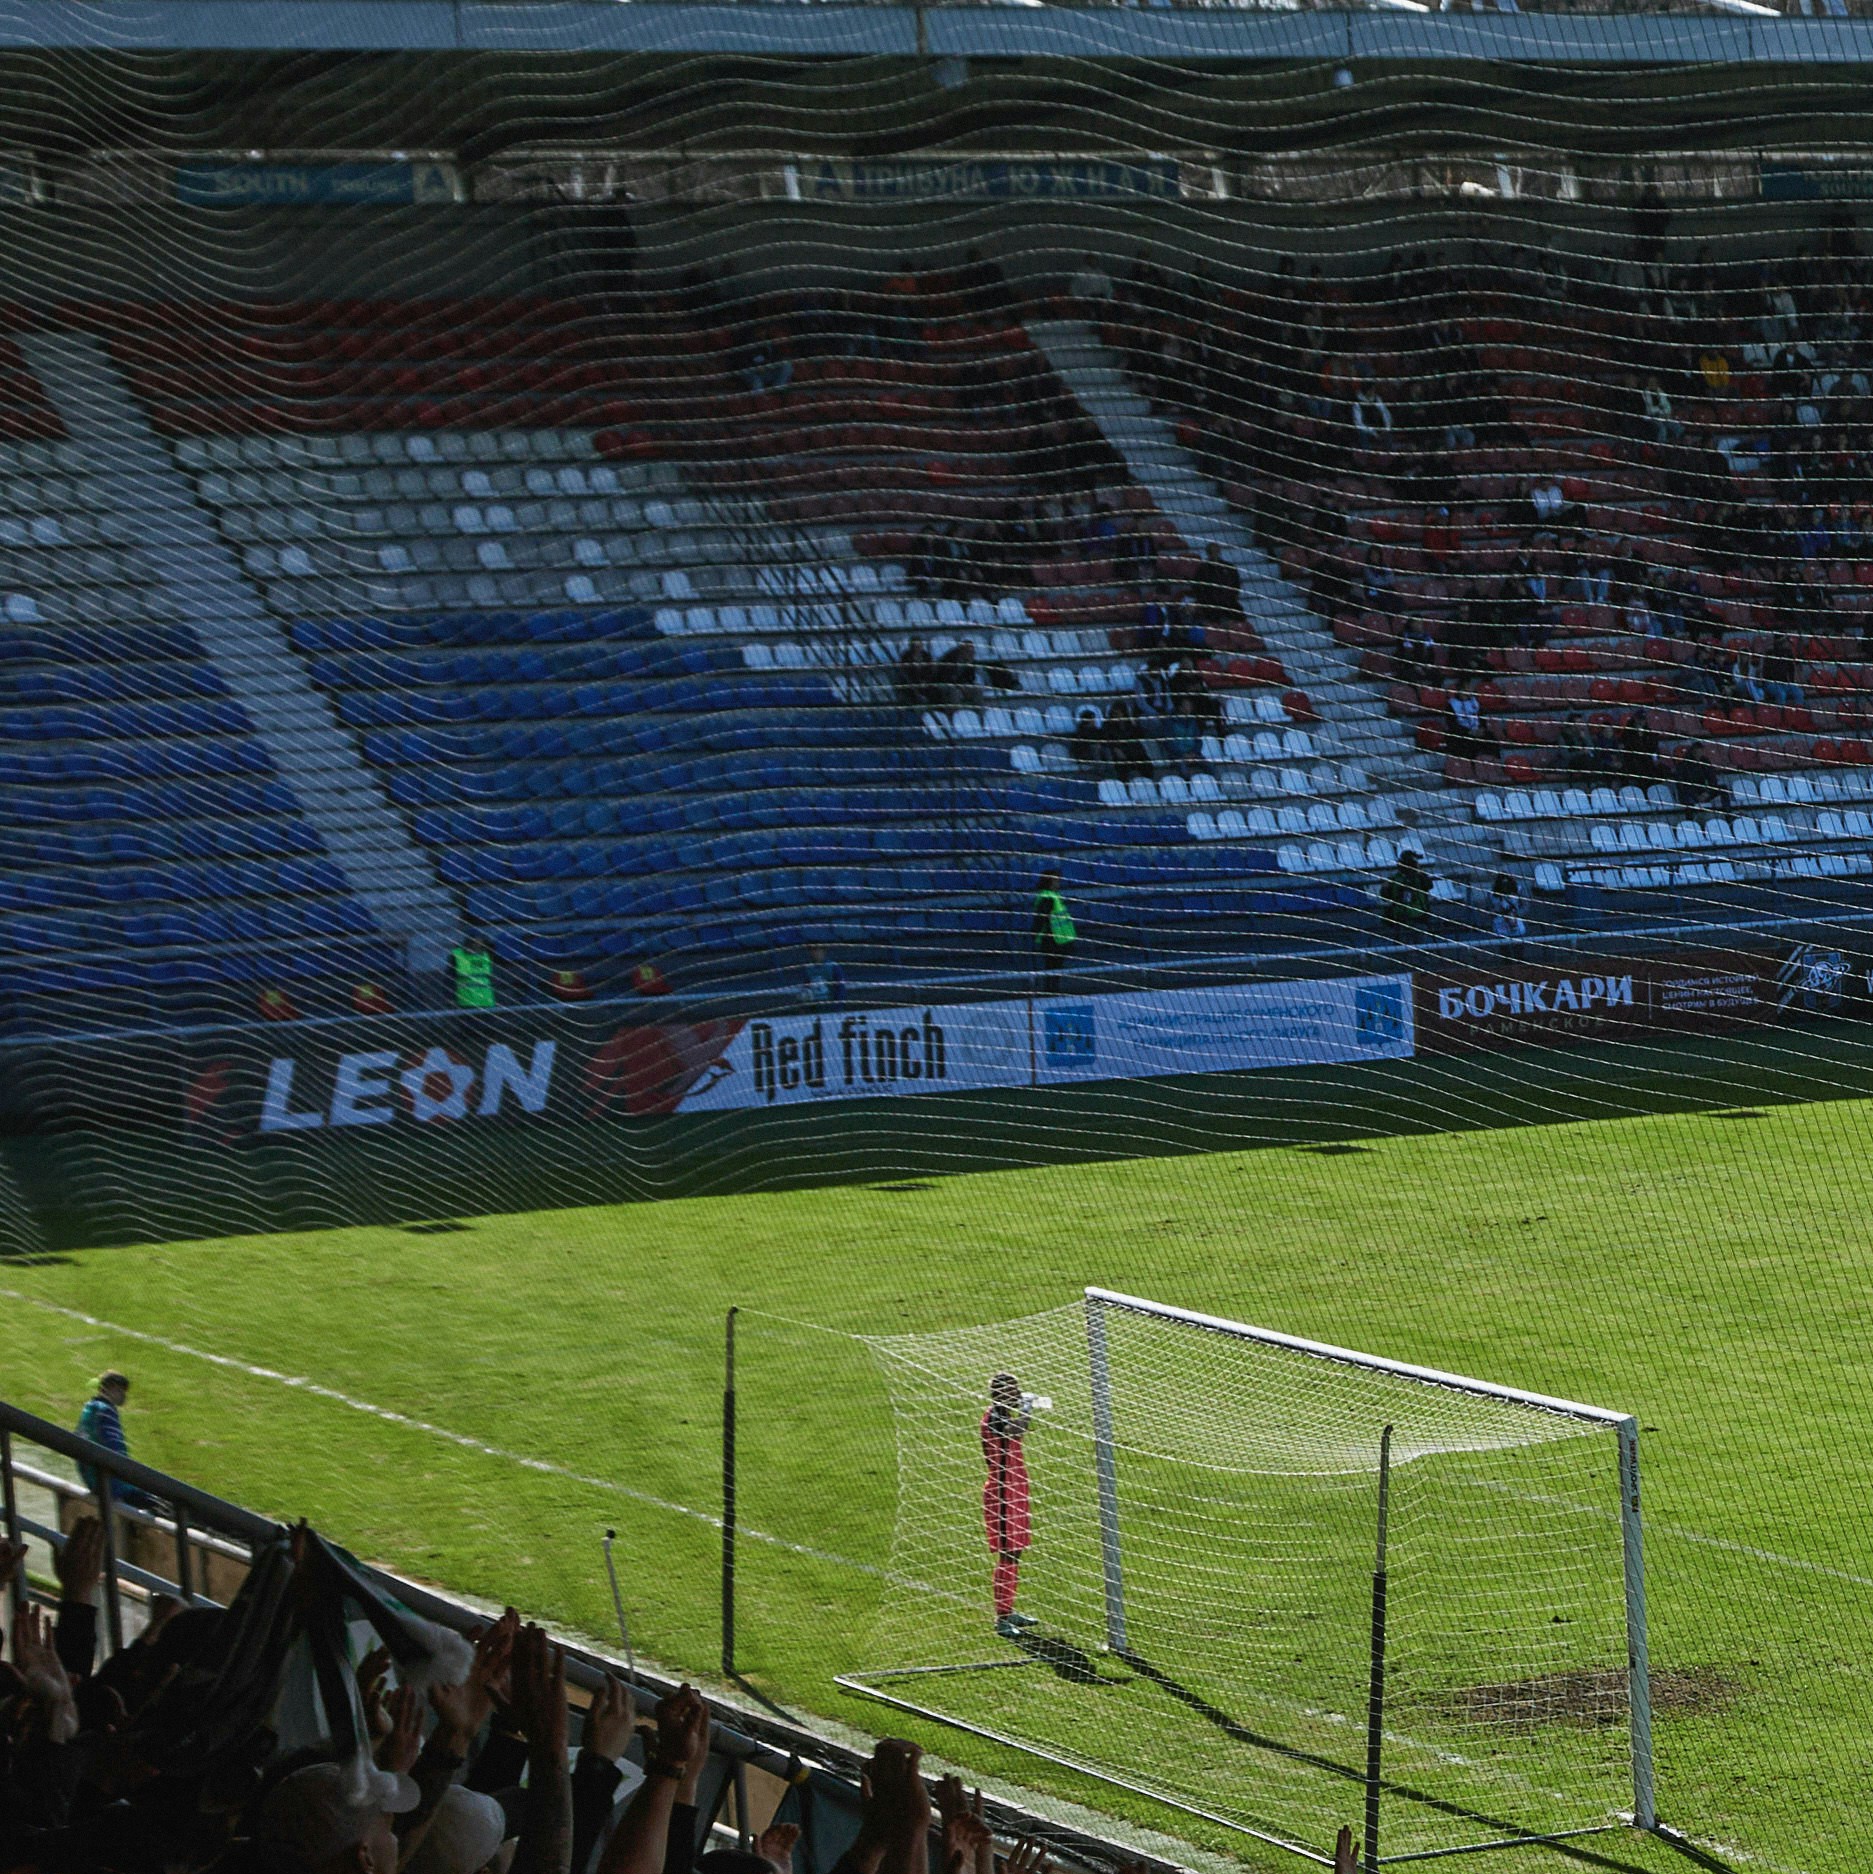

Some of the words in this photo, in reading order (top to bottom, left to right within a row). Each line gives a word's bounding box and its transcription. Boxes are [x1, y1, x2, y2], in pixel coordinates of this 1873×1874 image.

[1439, 974, 1633, 1019] БОЧКАРИ
[751, 1018, 825, 1104] Red
[838, 1010, 947, 1086] finch
